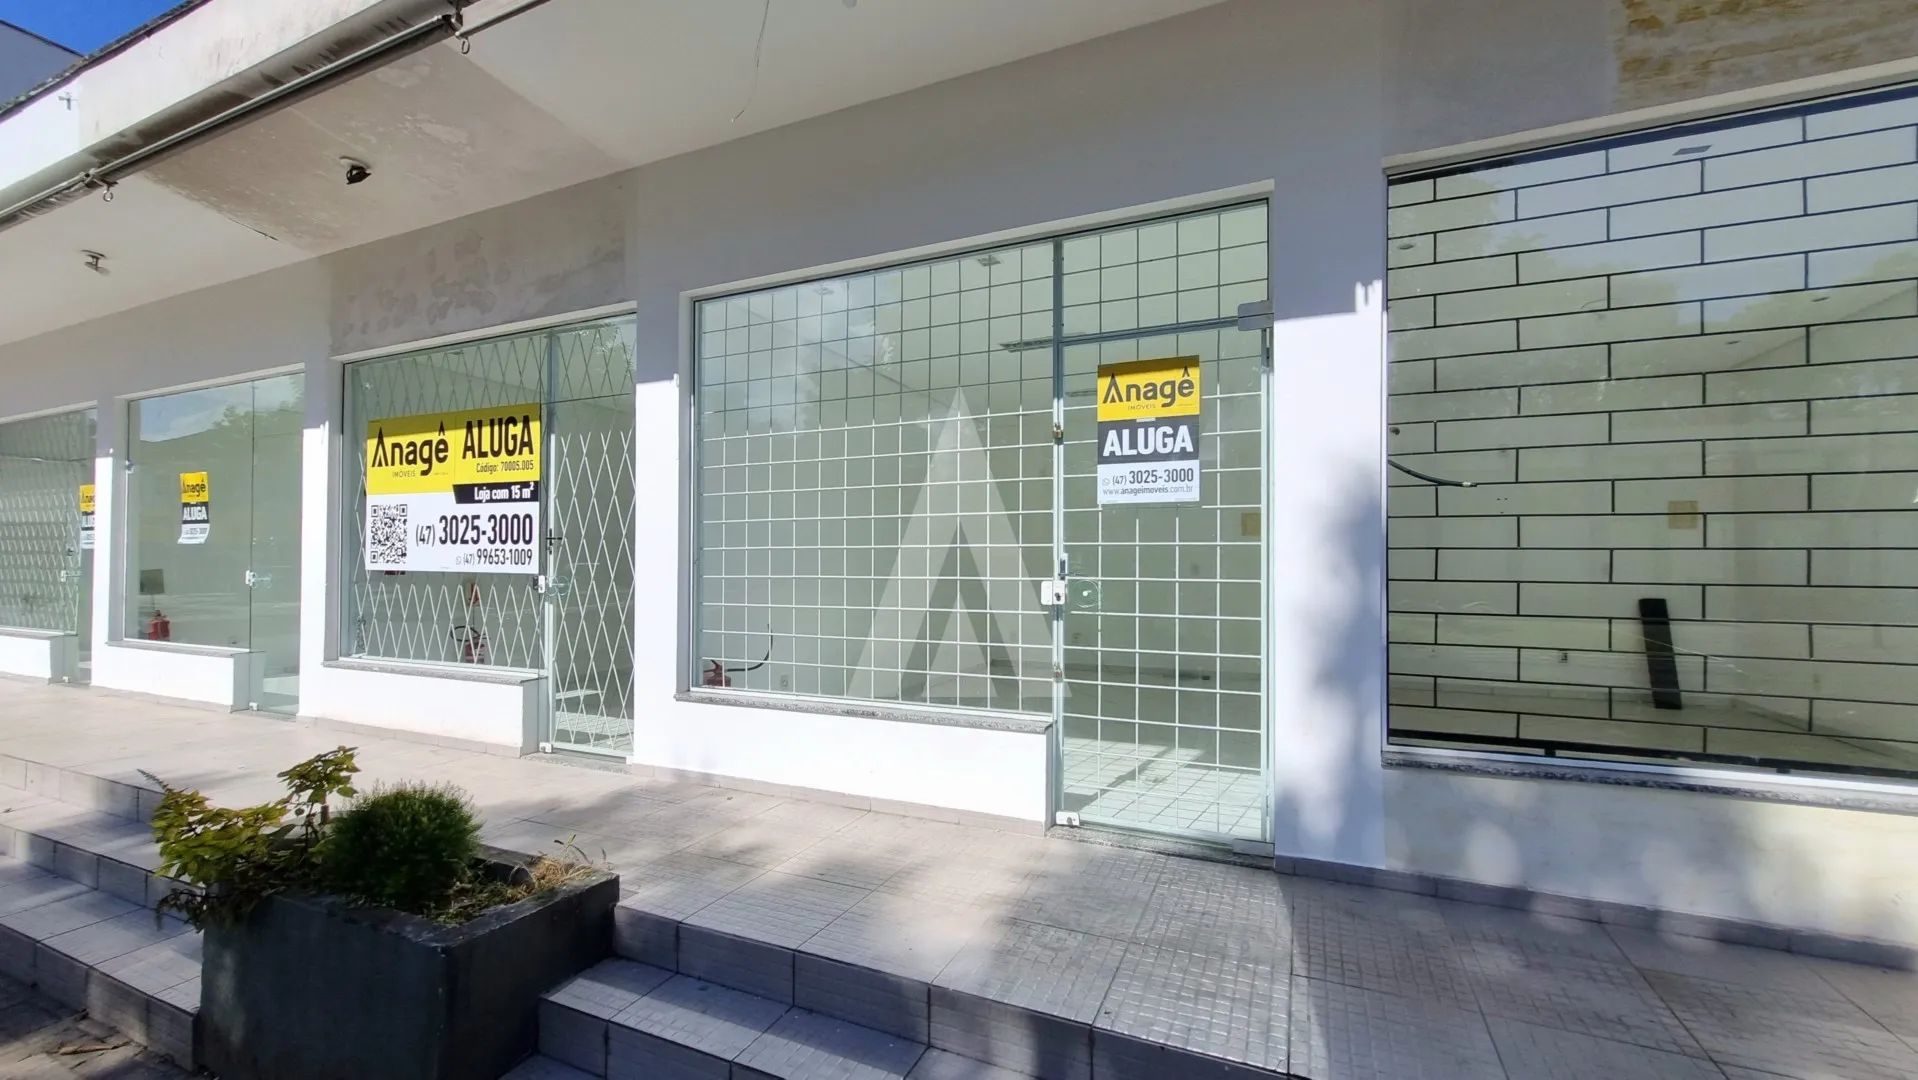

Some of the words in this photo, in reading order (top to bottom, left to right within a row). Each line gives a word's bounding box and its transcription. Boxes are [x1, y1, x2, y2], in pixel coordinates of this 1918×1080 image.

[1102, 365, 1195, 408] Anagê
[462, 415, 534, 459] ALUGA
[1102, 425, 1194, 456] ALUGA
[371, 420, 449, 476] Anagê
[476, 461, 499, 474] Código:
[500, 460, 534, 472] 70005.005
[1112, 475, 1127, 486] (47)
[1128, 468, 1194, 484] 3025-3000
[474, 487, 491, 503] Loja
[491, 488, 509, 500] com
[510, 486, 521, 499] 15
[1102, 485, 1193, 496] www.anageimoveis.com.br
[183, 506, 208, 521] ALUGA
[415, 524, 436, 547] (47)
[438, 513, 533, 545] 3025-3000
[463, 553, 476, 566] (47)
[476, 548, 533, 566] 99653-1009
